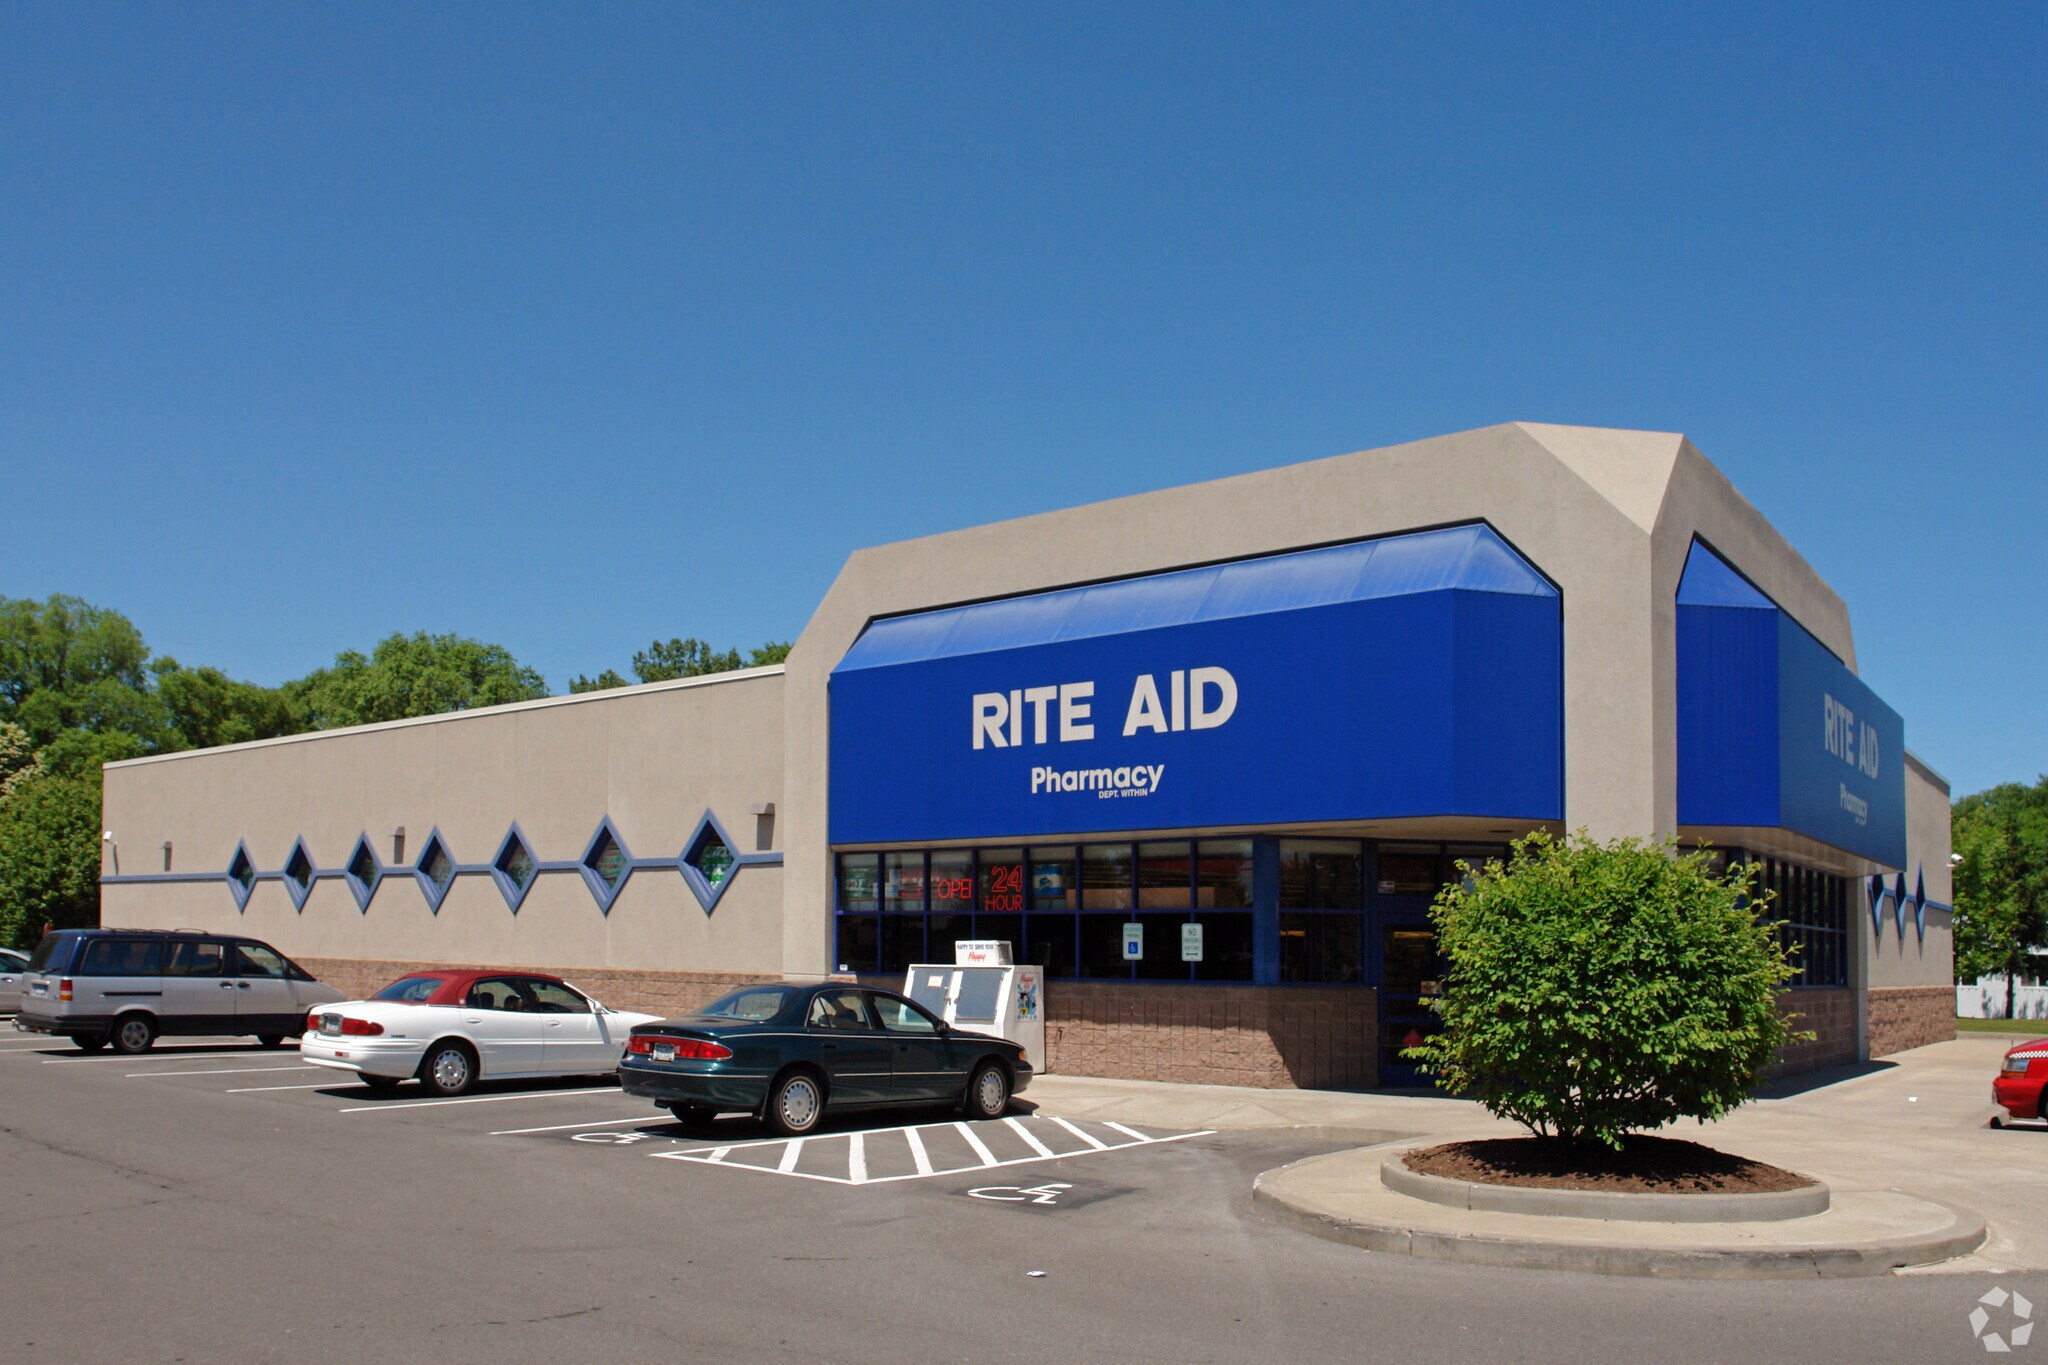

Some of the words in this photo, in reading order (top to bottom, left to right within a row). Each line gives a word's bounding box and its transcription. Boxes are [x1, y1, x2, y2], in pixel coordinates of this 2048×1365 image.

[972, 681, 1095, 750] RITE
[1122, 666, 1239, 736] AID
[1824, 692, 1854, 766] RITE
[1859, 720, 1879, 779] AID
[1031, 764, 1165, 794] Pharmacy
[1098, 789, 1119, 799] DEPT.
[1121, 788, 1148, 798] WITHIN
[937, 878, 972, 899] OPE
[991, 865, 1023, 893] 24
[985, 895, 1023, 911] HOUR
[1188, 928, 1197, 936] NO
[968, 951, 986, 962] Happy
